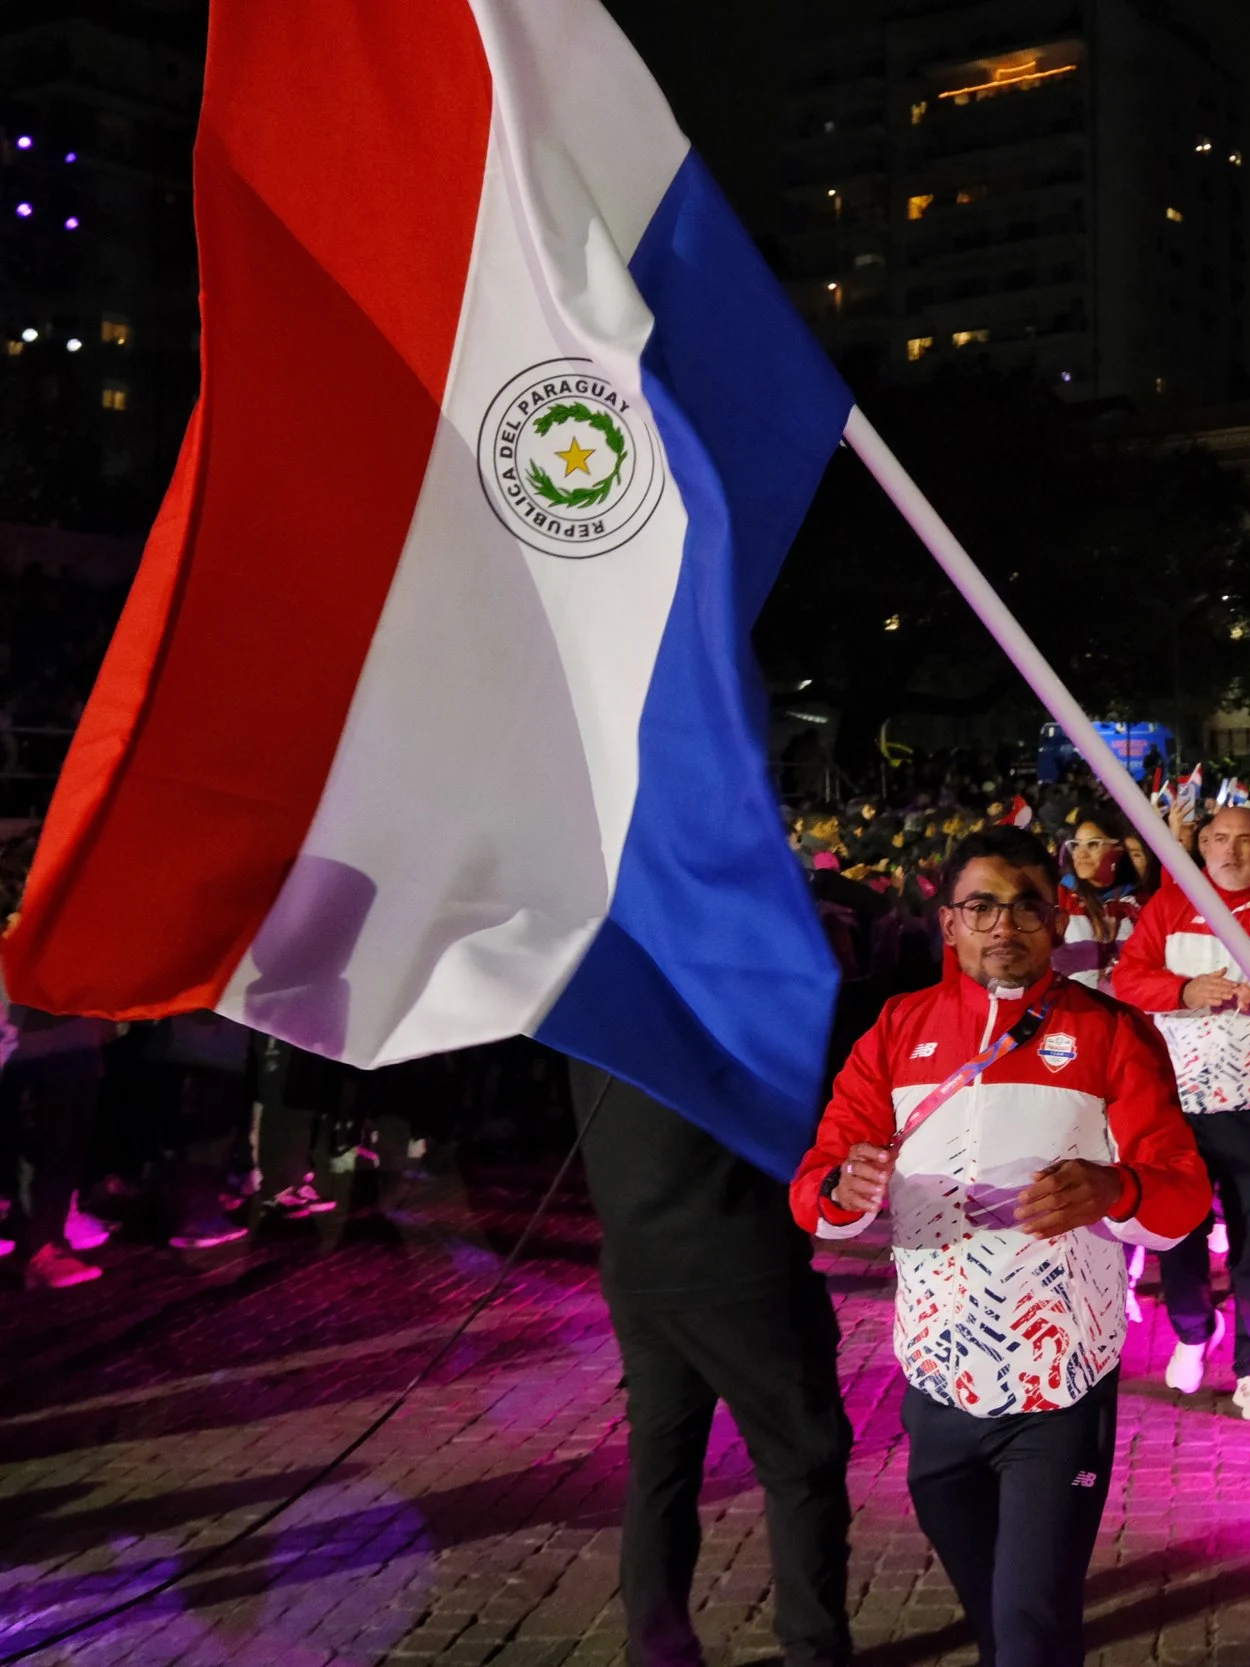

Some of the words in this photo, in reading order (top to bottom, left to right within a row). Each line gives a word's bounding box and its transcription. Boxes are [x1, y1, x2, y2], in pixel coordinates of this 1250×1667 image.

[518, 379, 630, 416] PARAGUAY
[500, 420, 521, 459] DEL
[502, 467, 606, 538] REPUBLICA
